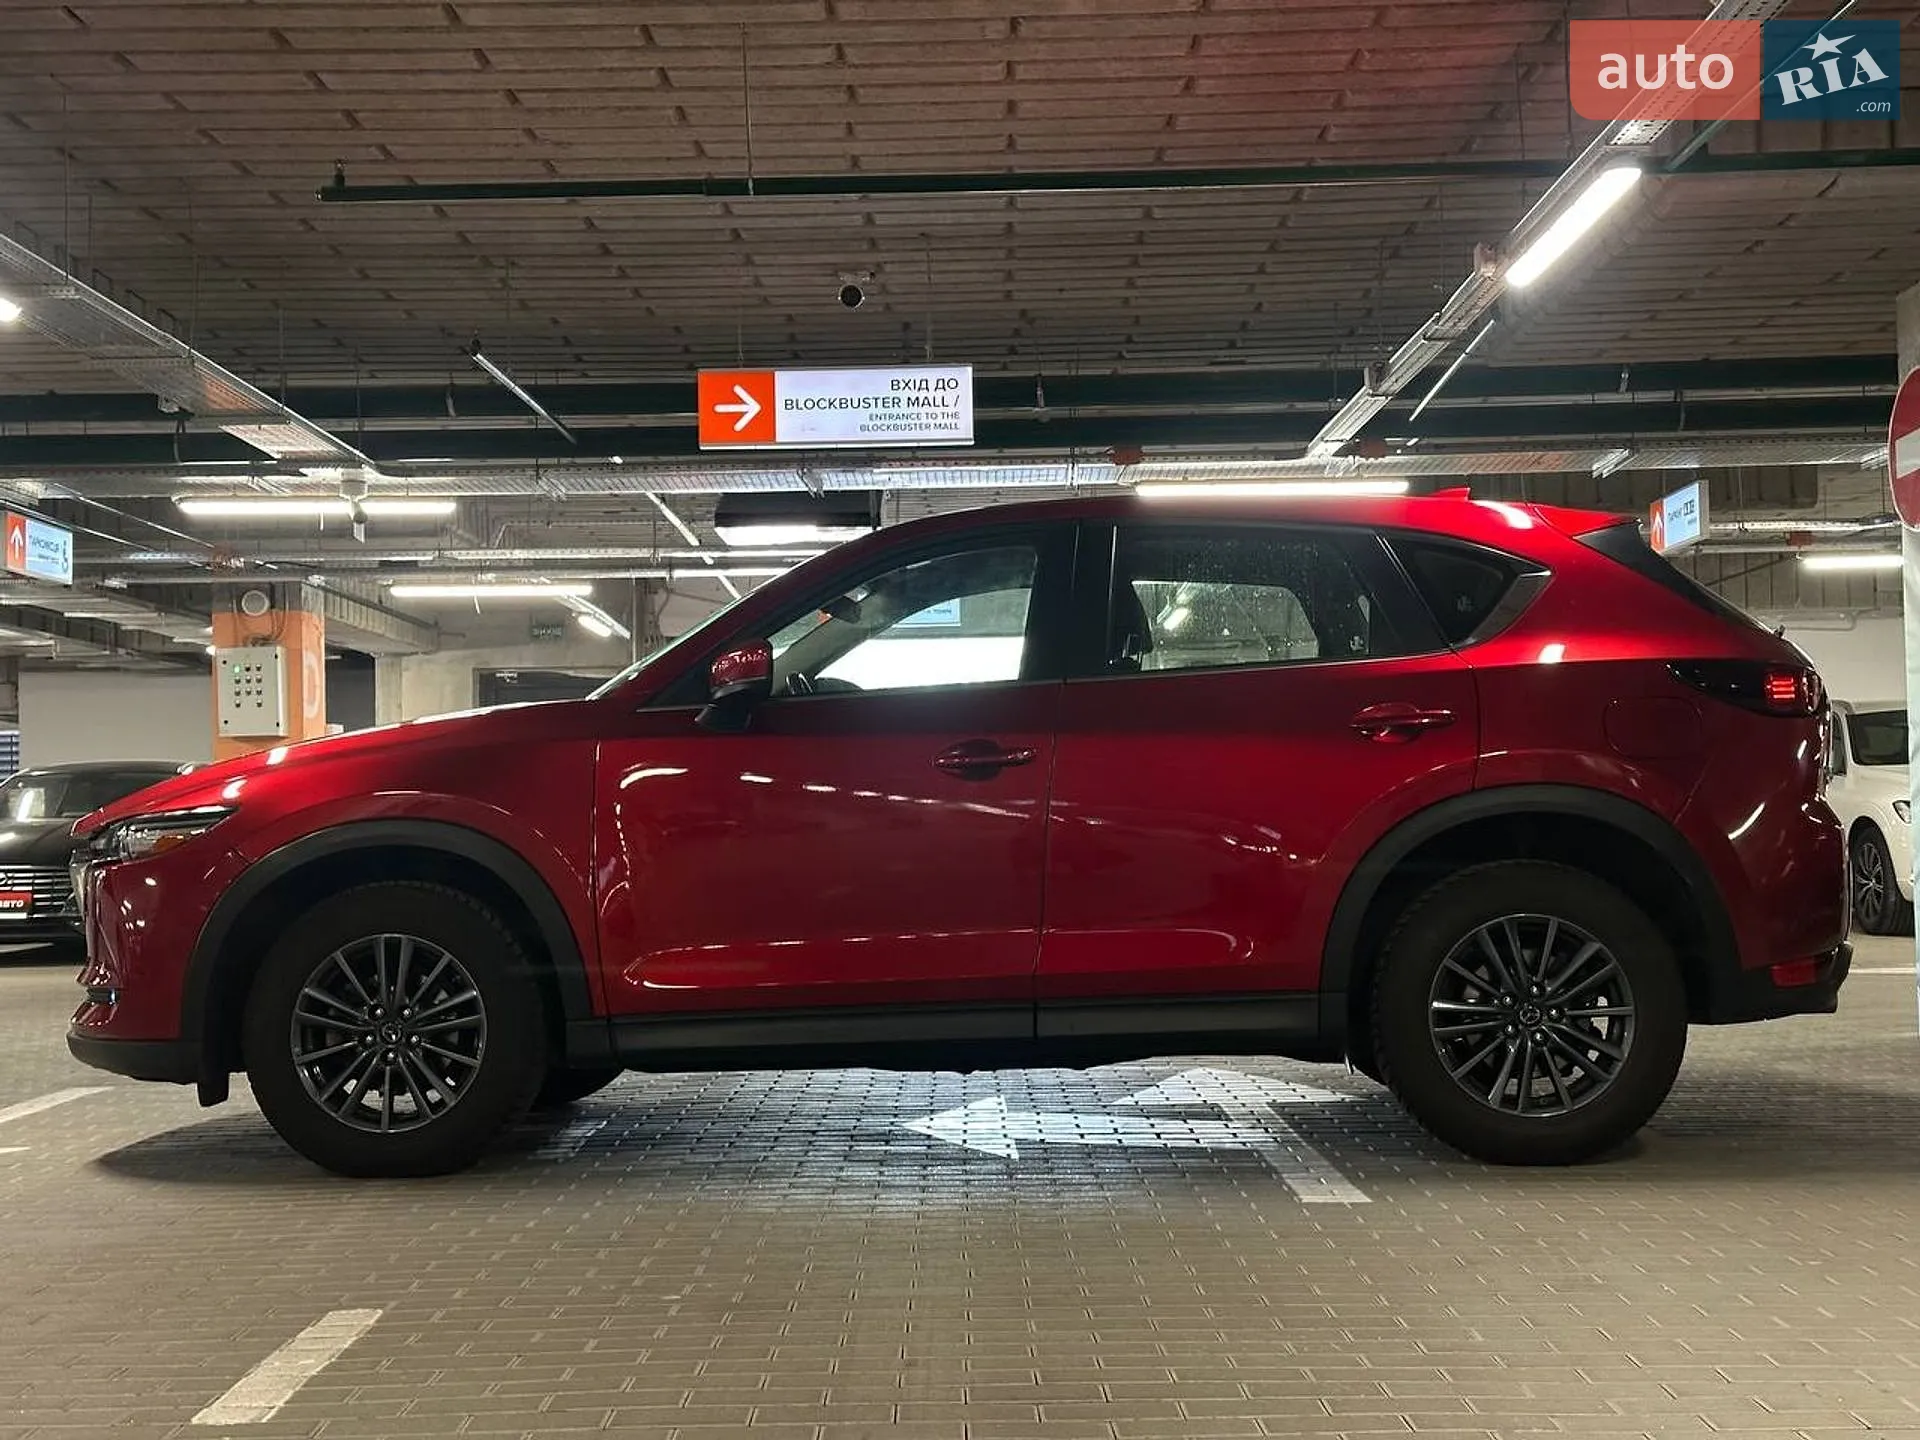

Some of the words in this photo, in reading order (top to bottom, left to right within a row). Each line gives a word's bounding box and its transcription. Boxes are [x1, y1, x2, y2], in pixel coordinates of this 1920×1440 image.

[890, 378, 930, 392] ВХІД
[934, 377, 959, 392] ДО
[784, 396, 901, 410] BLOCKBUSTER
[907, 395, 949, 409] MALL
[869, 412, 922, 421] ENTRANCE
[925, 412, 938, 420] TO
[941, 411, 960, 420] THE
[859, 423, 931, 432] BLOCKBUSTER
[933, 422, 960, 431] MALL
